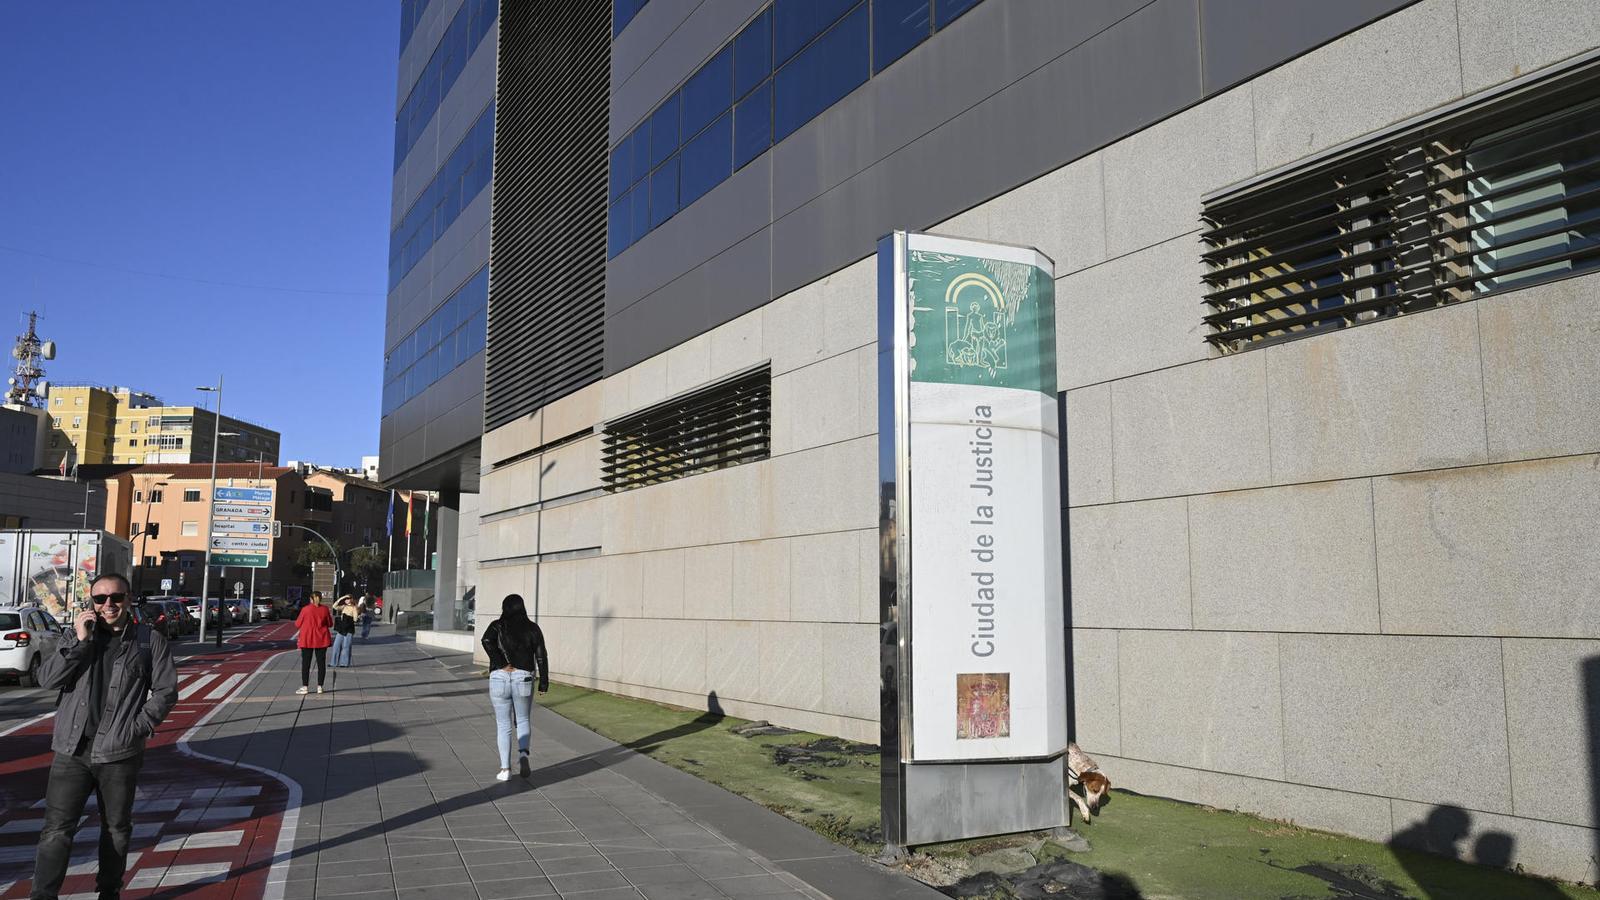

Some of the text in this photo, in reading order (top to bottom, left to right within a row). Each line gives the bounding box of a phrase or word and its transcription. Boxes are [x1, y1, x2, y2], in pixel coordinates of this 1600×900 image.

[969, 404, 995, 658] Ciudad de la Justicia
